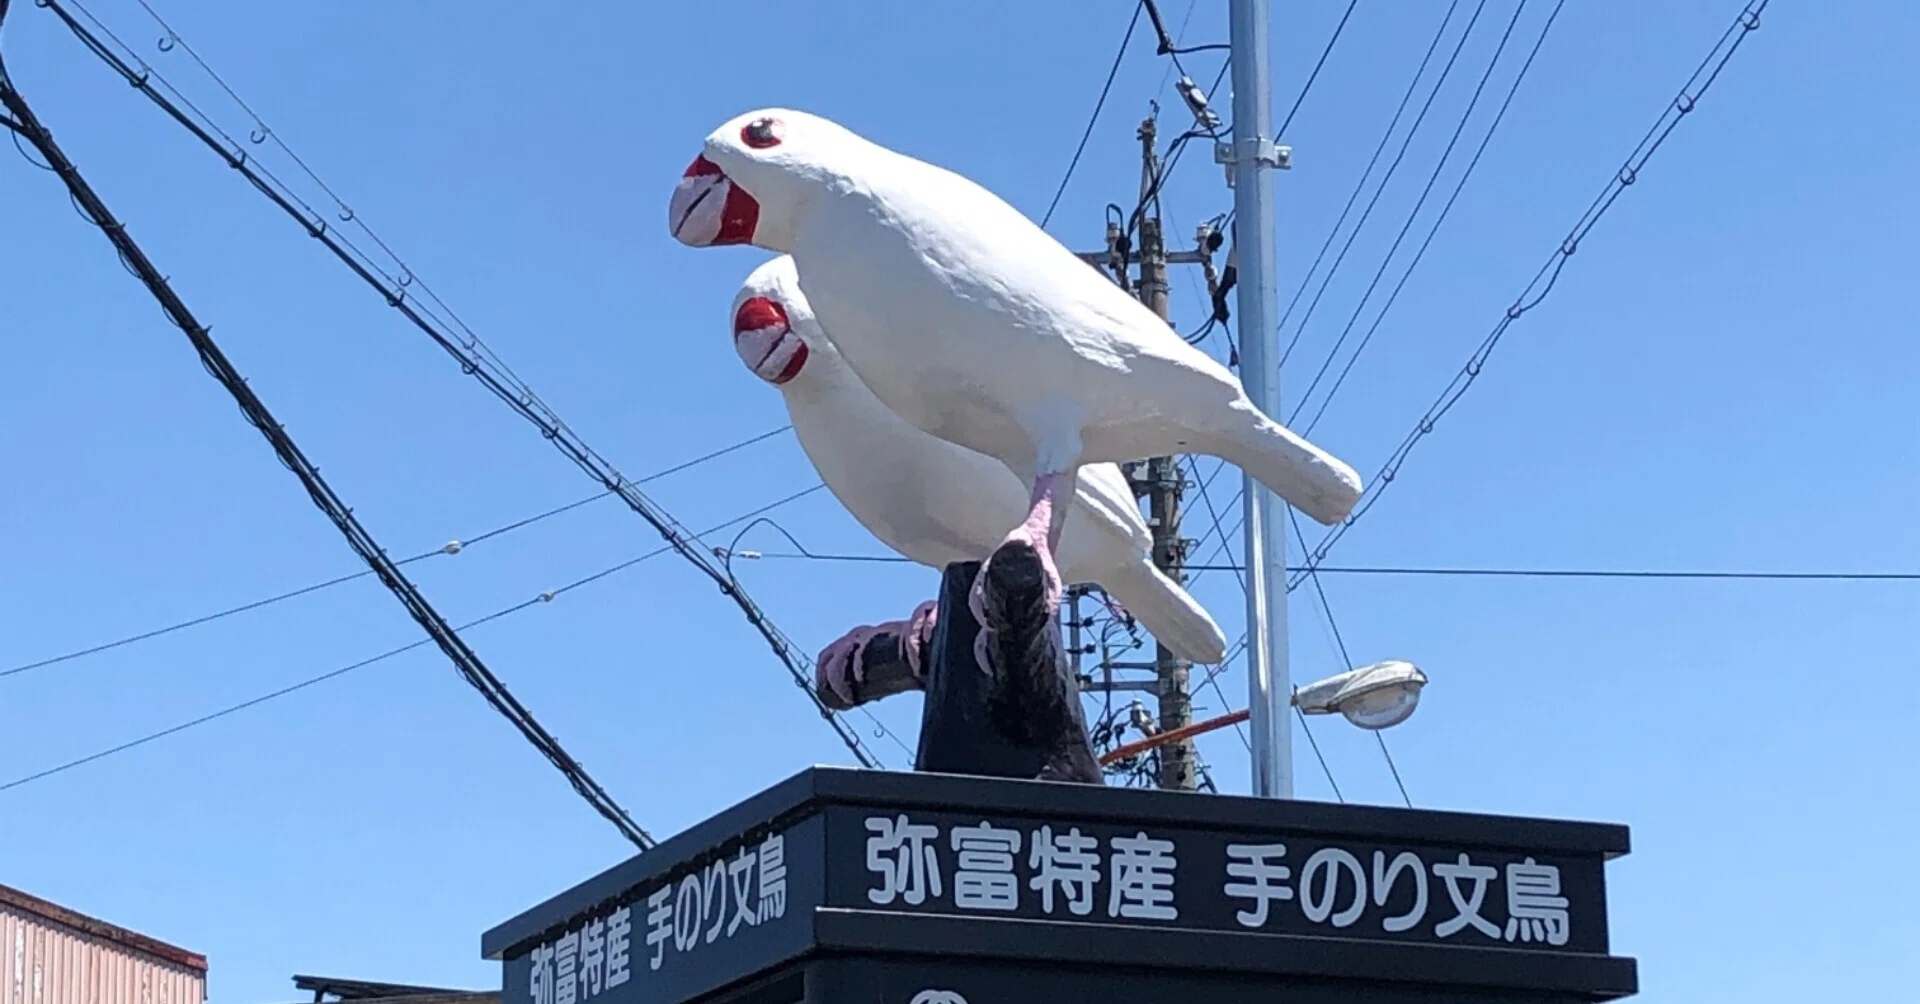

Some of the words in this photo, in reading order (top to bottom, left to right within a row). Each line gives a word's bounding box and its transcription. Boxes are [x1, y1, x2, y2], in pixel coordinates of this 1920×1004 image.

[530, 906, 631, 1004] 弥富特産
[646, 833, 787, 970] 手のり文鳥
[865, 815, 1178, 920] 弥富特産
[1224, 843, 1570, 946] 手のり文鳥
